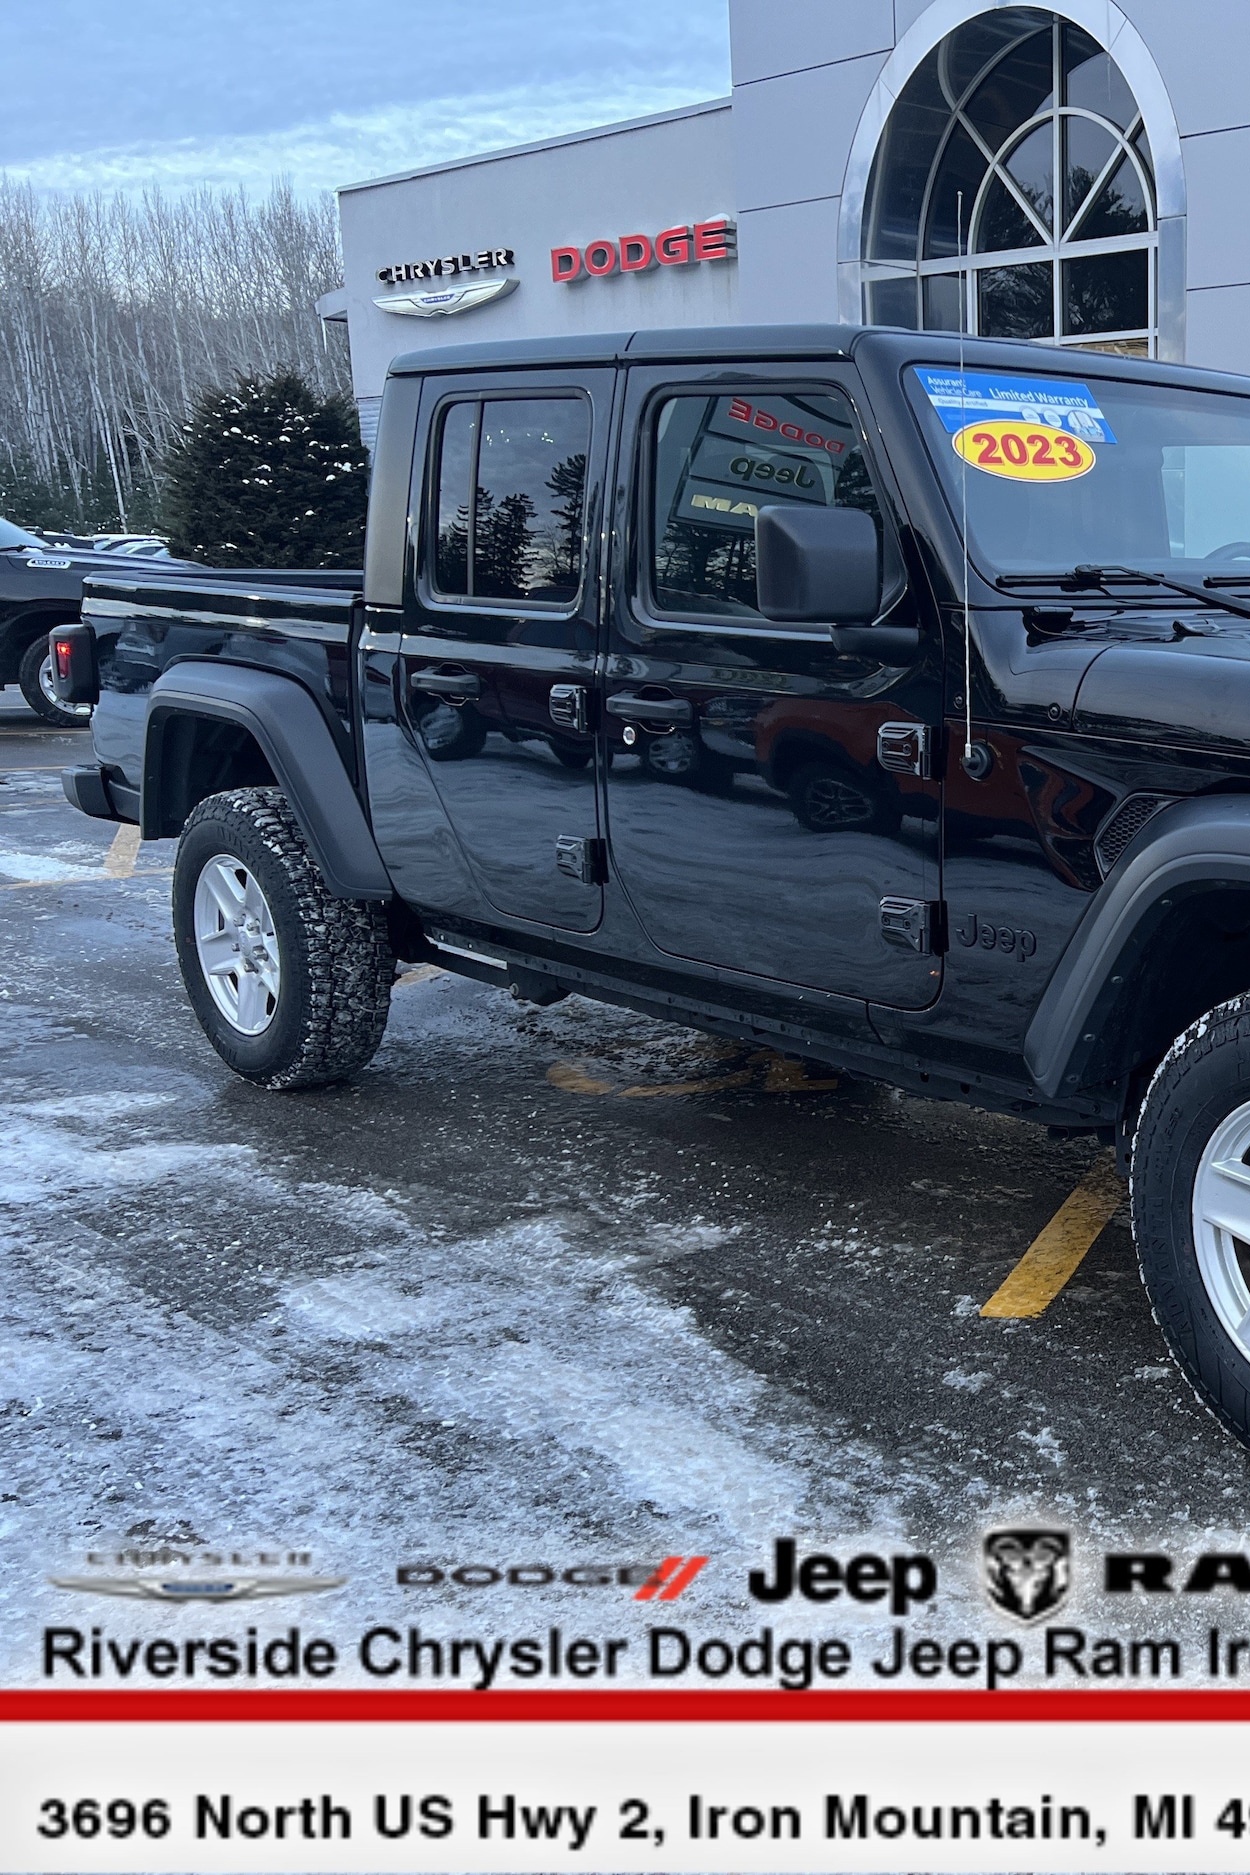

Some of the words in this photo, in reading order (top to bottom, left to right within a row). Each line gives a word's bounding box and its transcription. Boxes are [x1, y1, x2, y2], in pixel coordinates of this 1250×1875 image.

[376, 247, 514, 284] CHRYSLER
[551, 219, 736, 283] DODGE
[927, 376, 966, 388] Assurant
[931, 386, 962, 397] Vehicle
[962, 388, 982, 398] Care
[989, 388, 1036, 403] Limited
[1035, 391, 1088, 408] Warranty
[972, 432, 1083, 468] 2023
[956, 913, 1037, 962] Jeep
